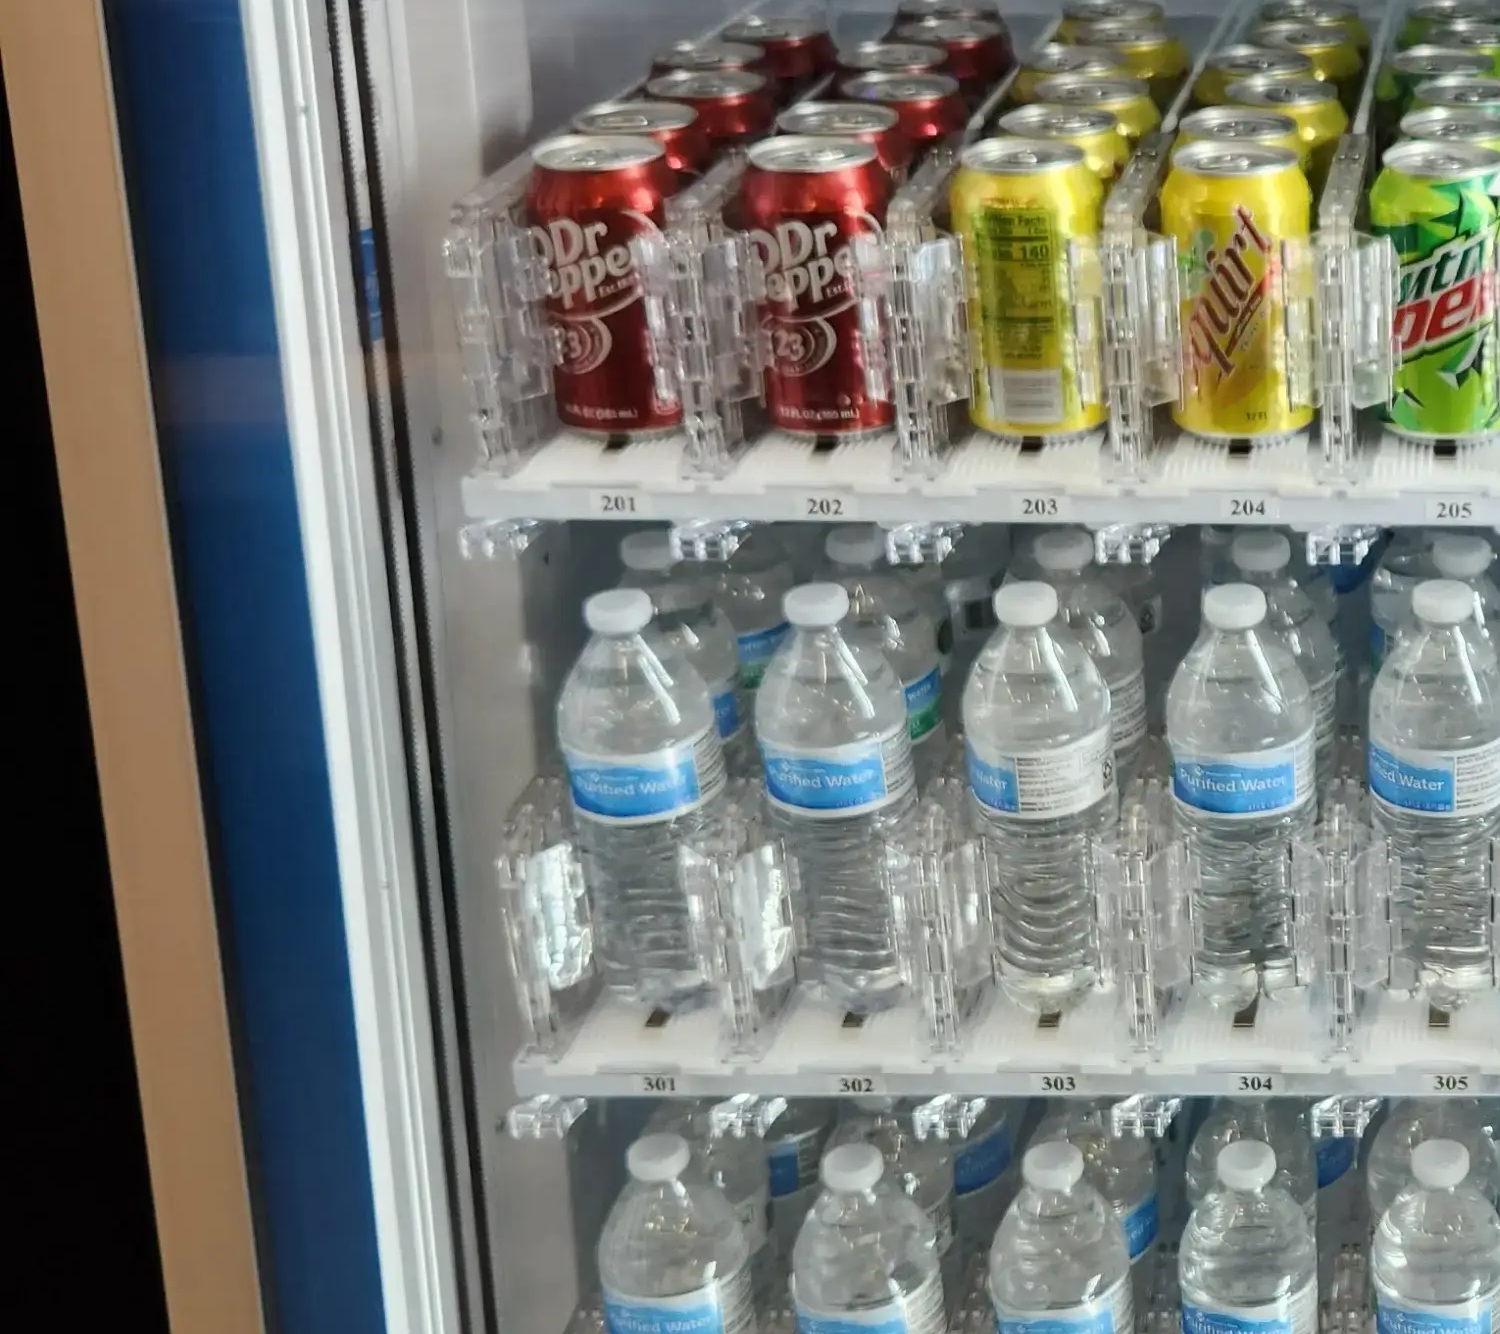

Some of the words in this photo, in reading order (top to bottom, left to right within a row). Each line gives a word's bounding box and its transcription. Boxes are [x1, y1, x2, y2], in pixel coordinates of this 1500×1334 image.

[549, 216, 608, 267] Dr
[774, 220, 838, 268] Dr
[1020, 244, 1050, 261] 140
[774, 330, 805, 361] 23
[602, 496, 636, 512] 201
[807, 499, 842, 515] 202
[1023, 499, 1058, 514] 203
[1231, 500, 1265, 515] 204
[1436, 503, 1472, 518] 205
[825, 771, 873, 787] Water
[1180, 768, 1237, 793] Purified
[1241, 774, 1286, 792] Water
[1399, 771, 1445, 791] Water
[643, 1077, 676, 1092] 301
[840, 1079, 873, 1093] 302
[1041, 1077, 1076, 1092] 303
[1238, 1077, 1273, 1091] 304
[1434, 1076, 1468, 1091] 305
[665, 1316, 710, 1334] Water
